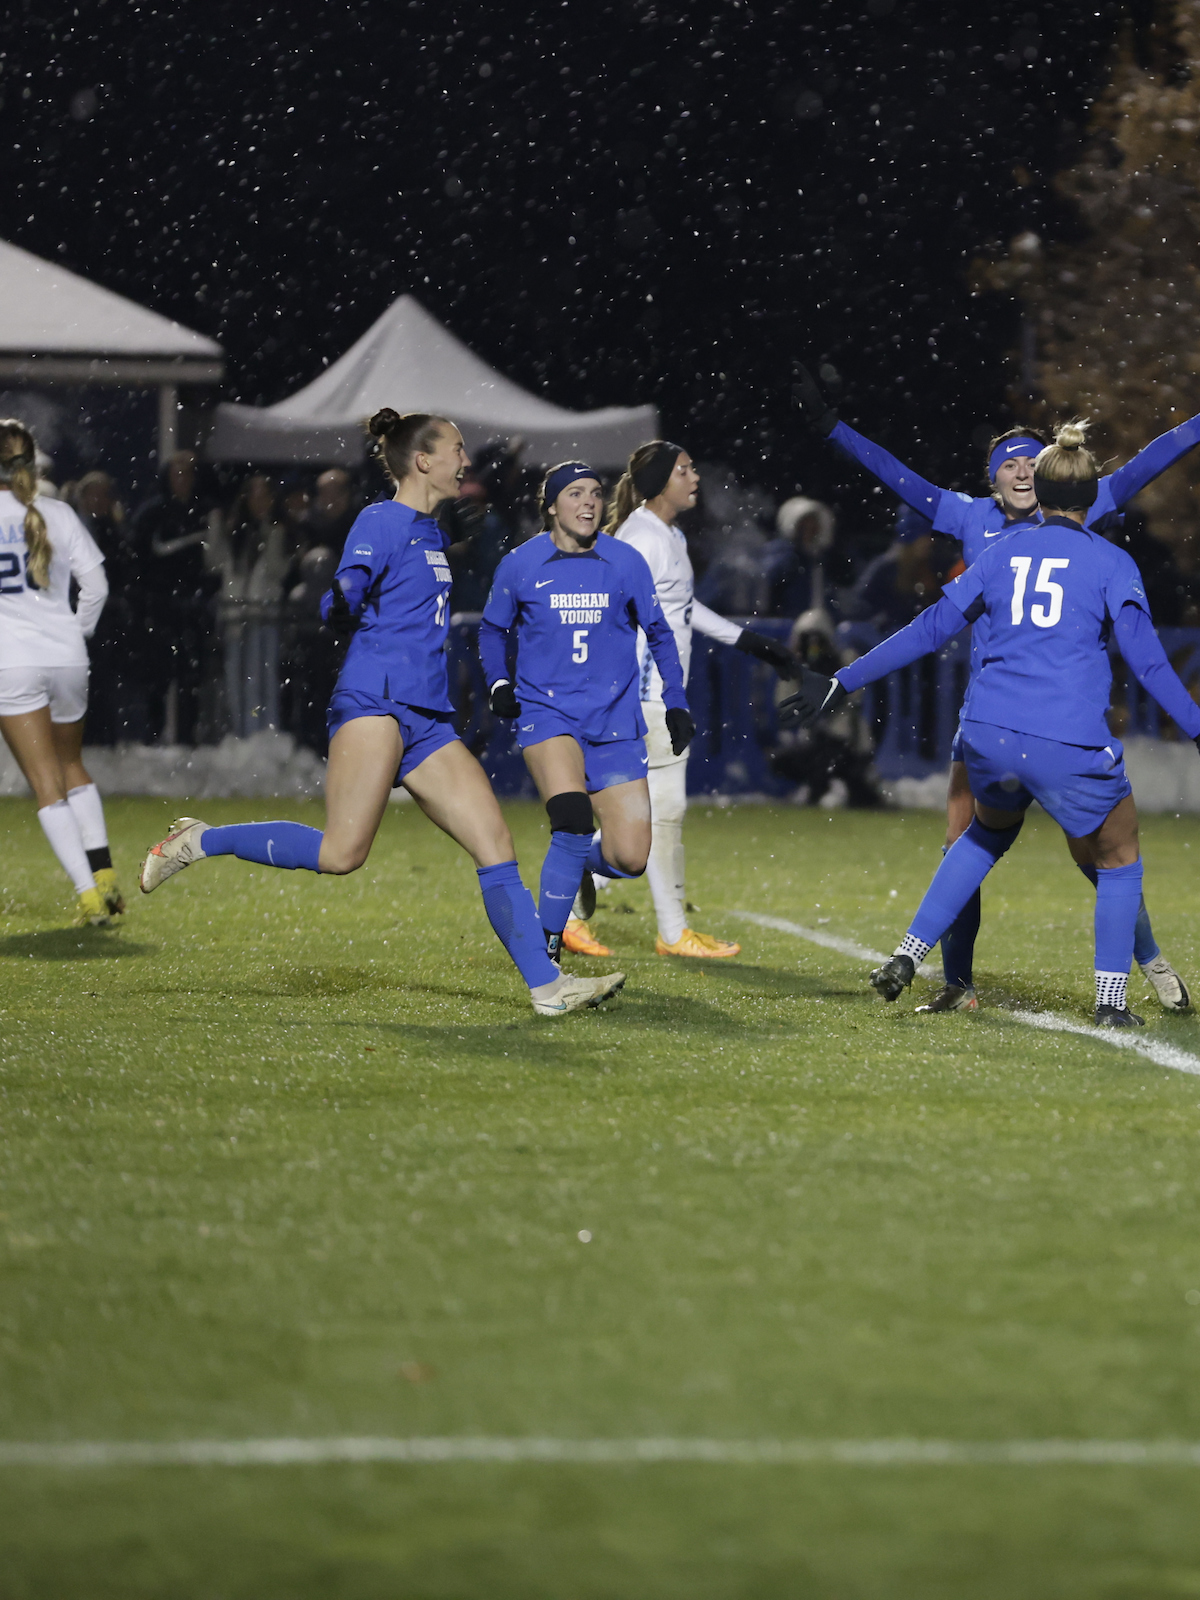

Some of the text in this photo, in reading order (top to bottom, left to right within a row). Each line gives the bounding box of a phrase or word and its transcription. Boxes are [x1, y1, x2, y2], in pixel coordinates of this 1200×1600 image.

[550, 593, 609, 608] BRIGHAM
[1010, 556, 1070, 628] 15
[559, 610, 602, 624] YOUNG
[572, 630, 589, 664] 5
